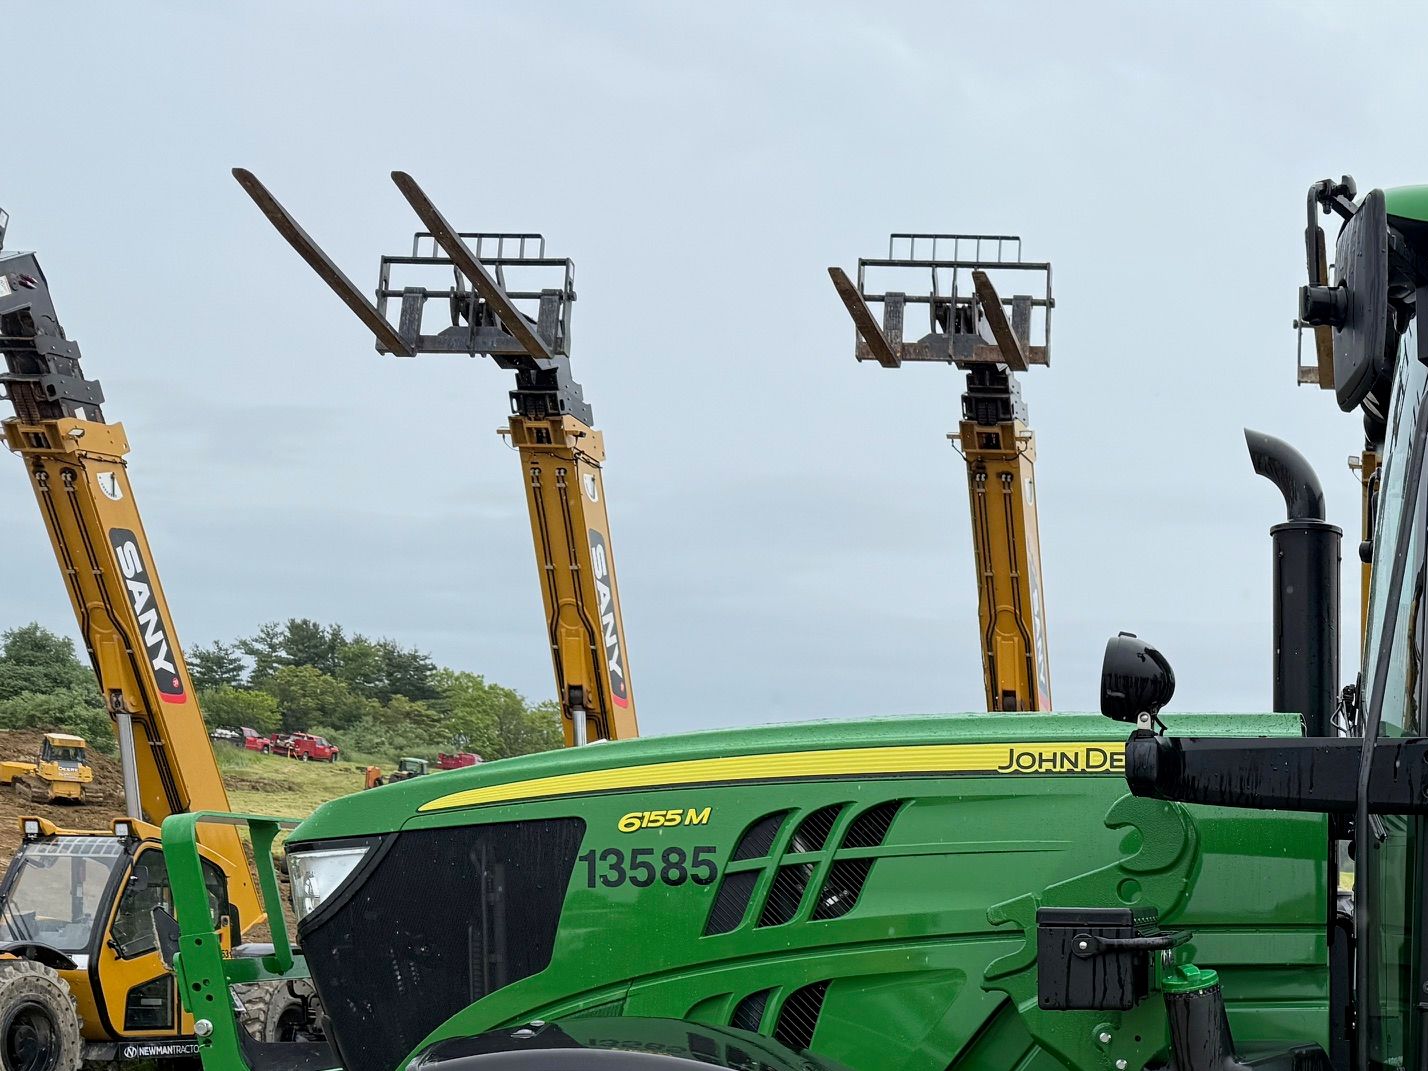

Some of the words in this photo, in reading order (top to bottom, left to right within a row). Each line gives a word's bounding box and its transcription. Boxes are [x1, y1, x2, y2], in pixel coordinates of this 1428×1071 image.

[115, 540, 176, 675] SANY
[591, 543, 624, 680] SANY
[997, 747, 1079, 770] JOHN
[1085, 747, 1126, 769] DE
[578, 845, 718, 889] 13585
[139, 1044, 200, 1056] NEWMANTRACTO
